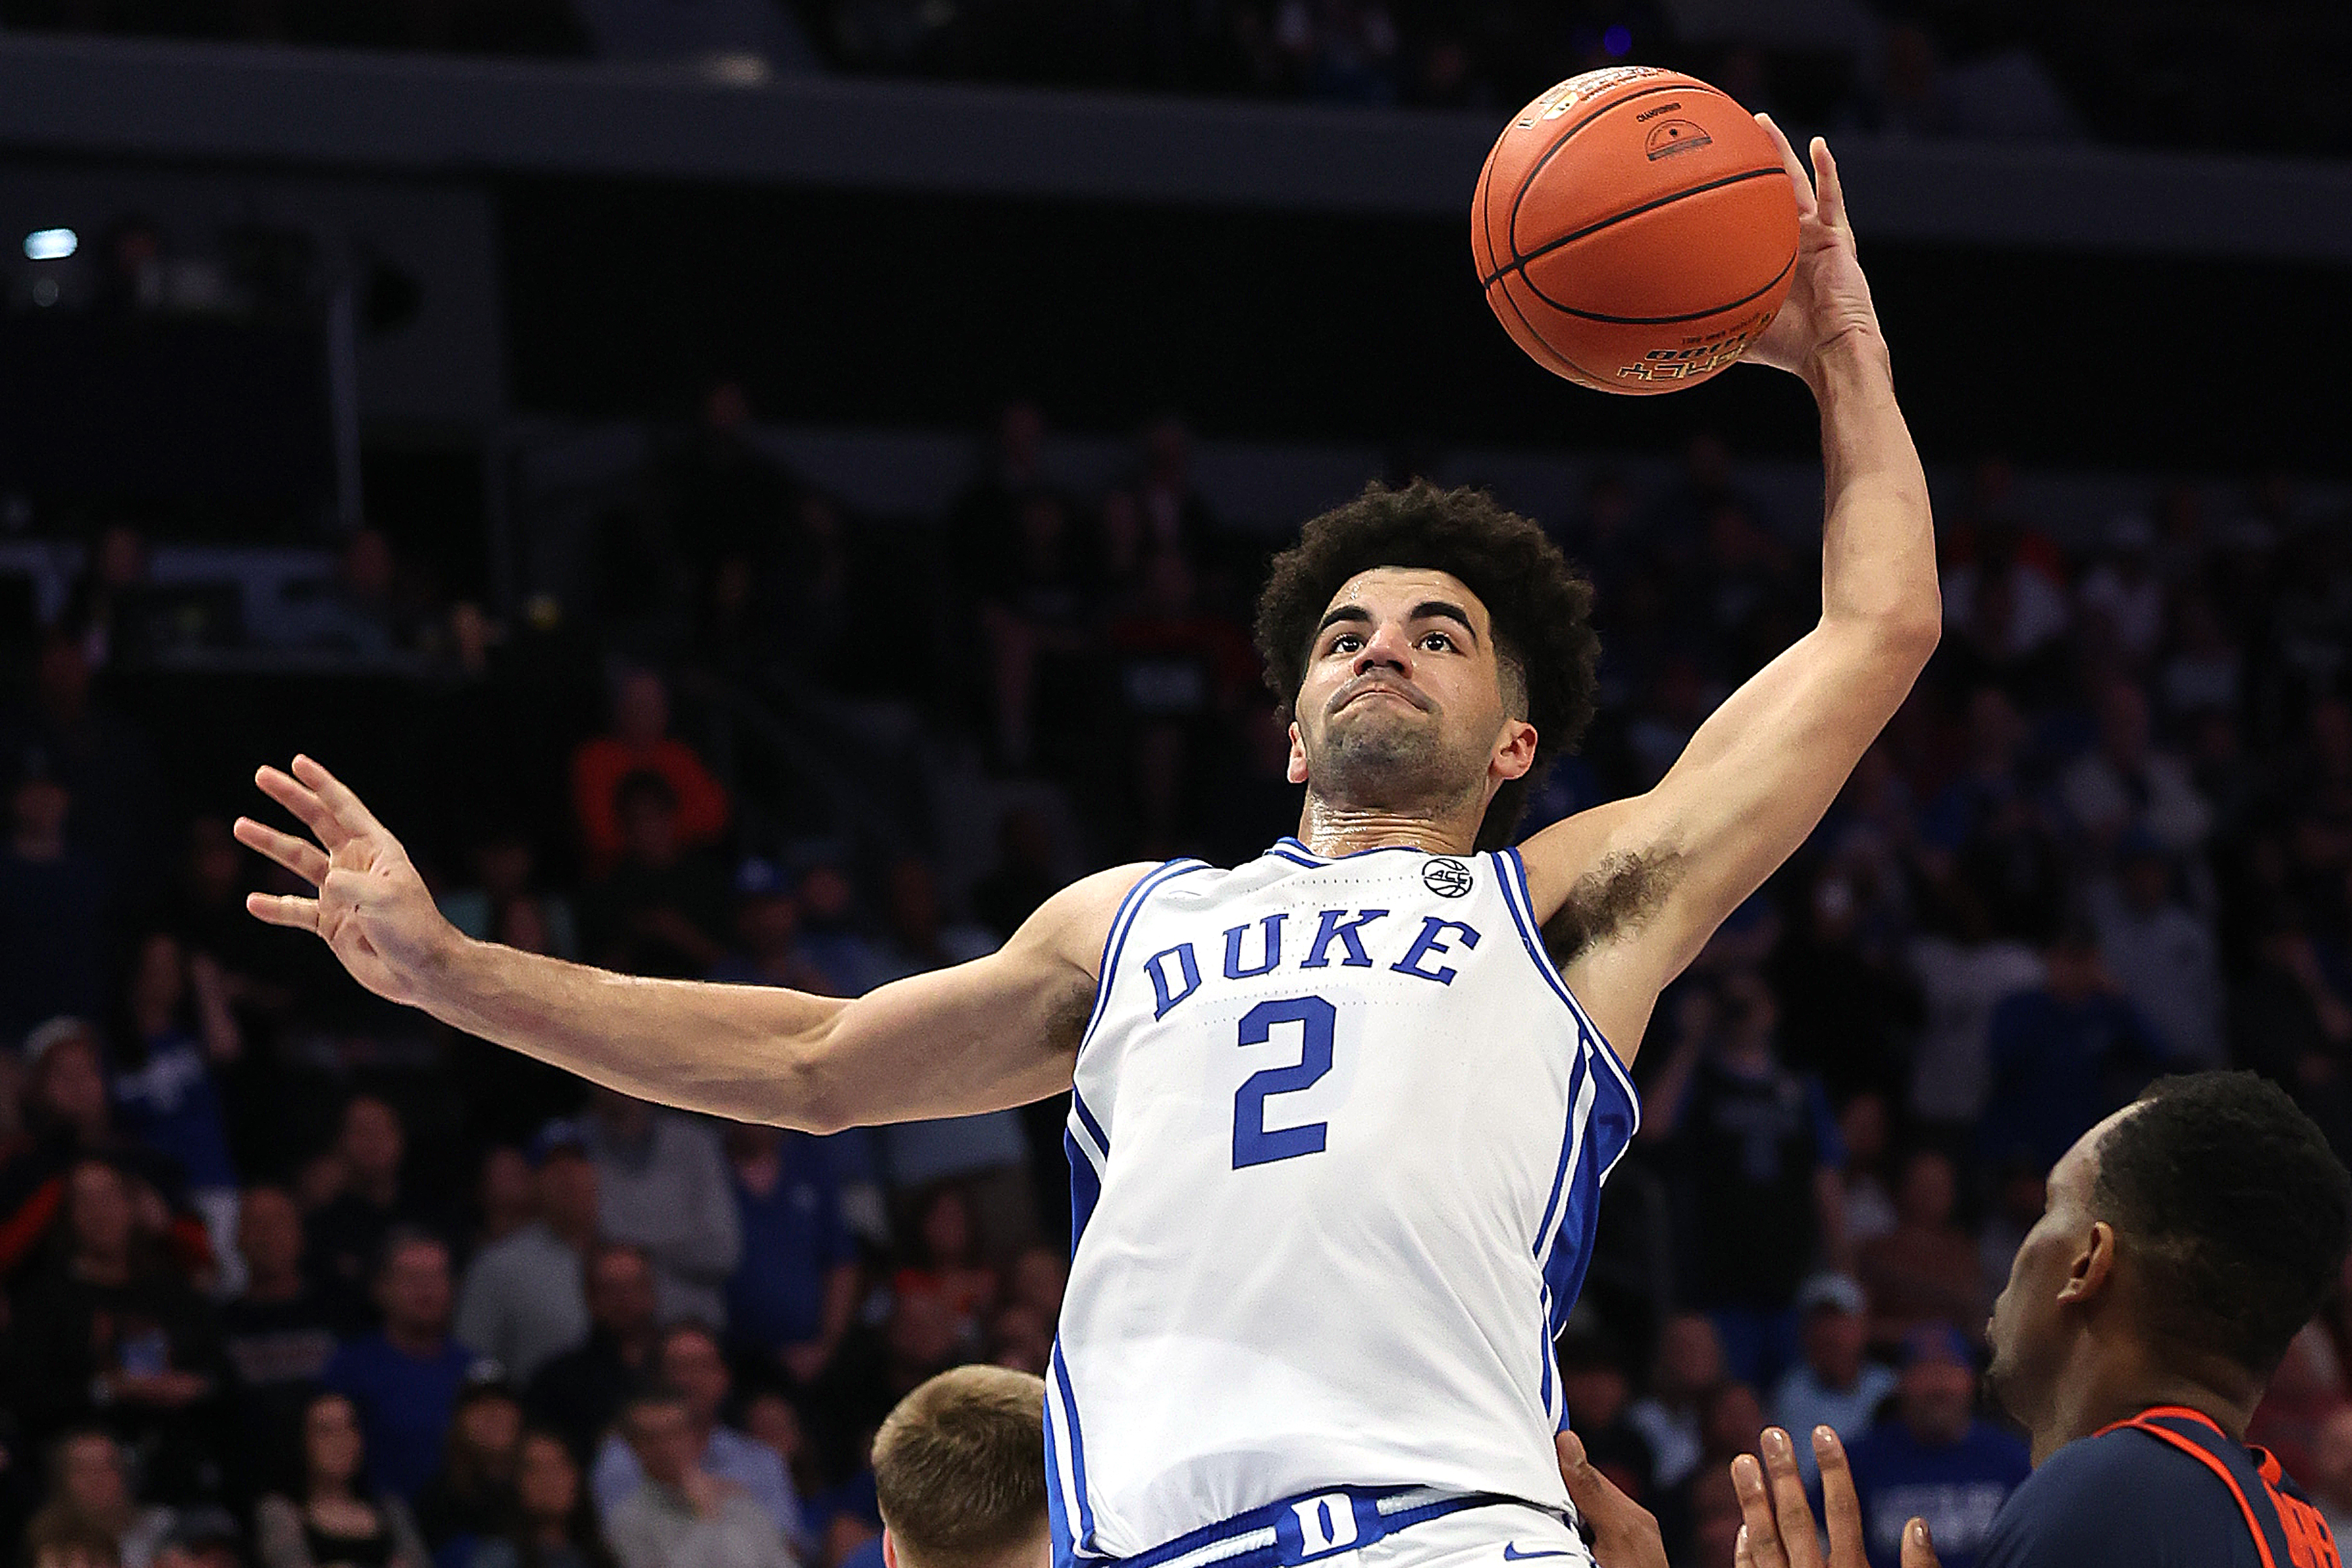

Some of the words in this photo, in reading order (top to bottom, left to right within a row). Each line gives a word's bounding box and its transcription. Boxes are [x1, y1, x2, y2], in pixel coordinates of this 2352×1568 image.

[1429, 870, 1469, 885] ACC
[1144, 909, 1482, 1022] DUKE
[1232, 994, 1337, 1170] 2
[1290, 1492, 1360, 1557] D
